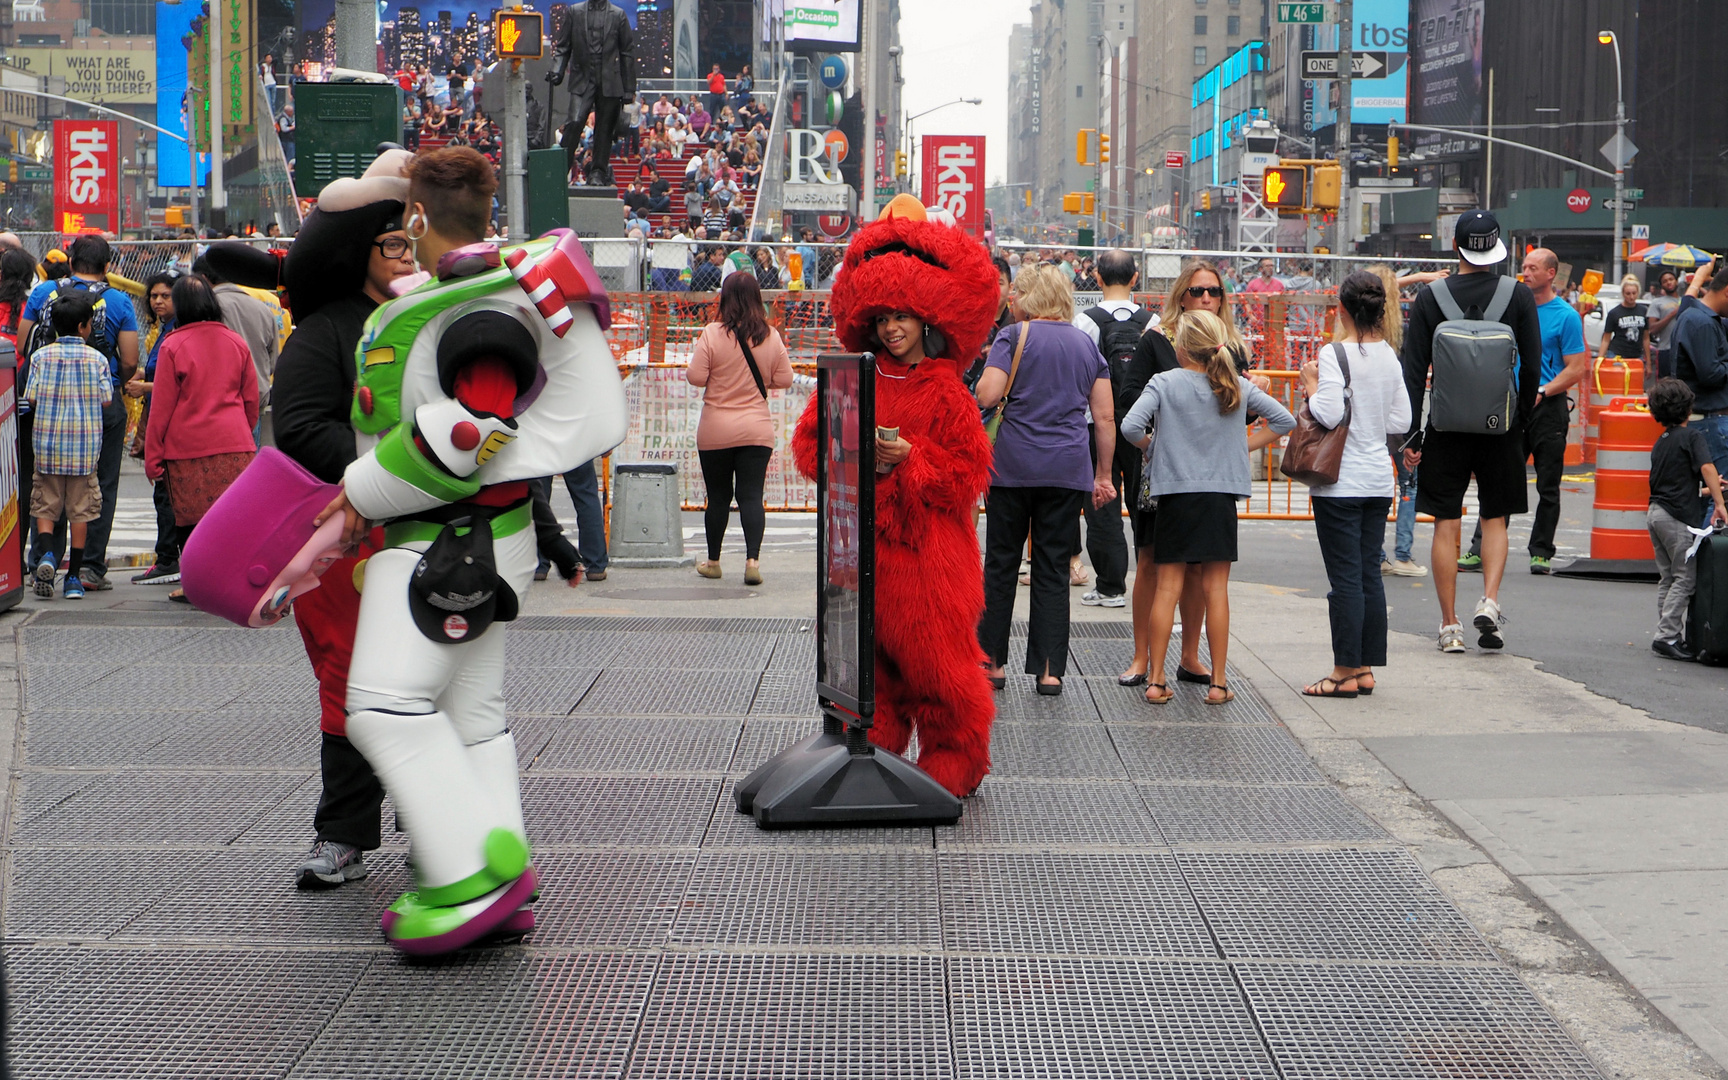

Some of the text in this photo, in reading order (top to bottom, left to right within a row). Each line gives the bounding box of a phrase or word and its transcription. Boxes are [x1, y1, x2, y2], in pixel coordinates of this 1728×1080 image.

[797, 9, 838, 23] Occasions
[1281, 5, 1290, 21] W
[1293, 5, 1308, 21] 46
[1311, 5, 1321, 14] ST
[1360, 23, 1408, 47] tbs
[13, 55, 31, 70] UP
[66, 56, 130, 69] WHAT ARE
[1310, 60, 1364, 71] ONE AY
[76, 69, 145, 82] YOU DOING
[824, 66, 835, 78] m
[65, 82, 152, 94] DOWN THERE?
[229, 50, 243, 122] GARDEN
[1032, 47, 1041, 133] WELLINGTON
[1355, 98, 1405, 106] #BIGGERBALL
[70, 127, 108, 204] tkts
[937, 142, 976, 218] tkts
[785, 193, 848, 204] NAISSANCE
[1567, 195, 1591, 206] CNY
[1468, 236, 1485, 249] NEW
[1074, 296, 1103, 306] OSSWALK
[645, 368, 687, 381] TIME
[644, 418, 697, 433] TRANS
[643, 435, 696, 449] TRANS
[641, 450, 690, 460] TRAFFIC
[785, 488, 817, 501] HEA
